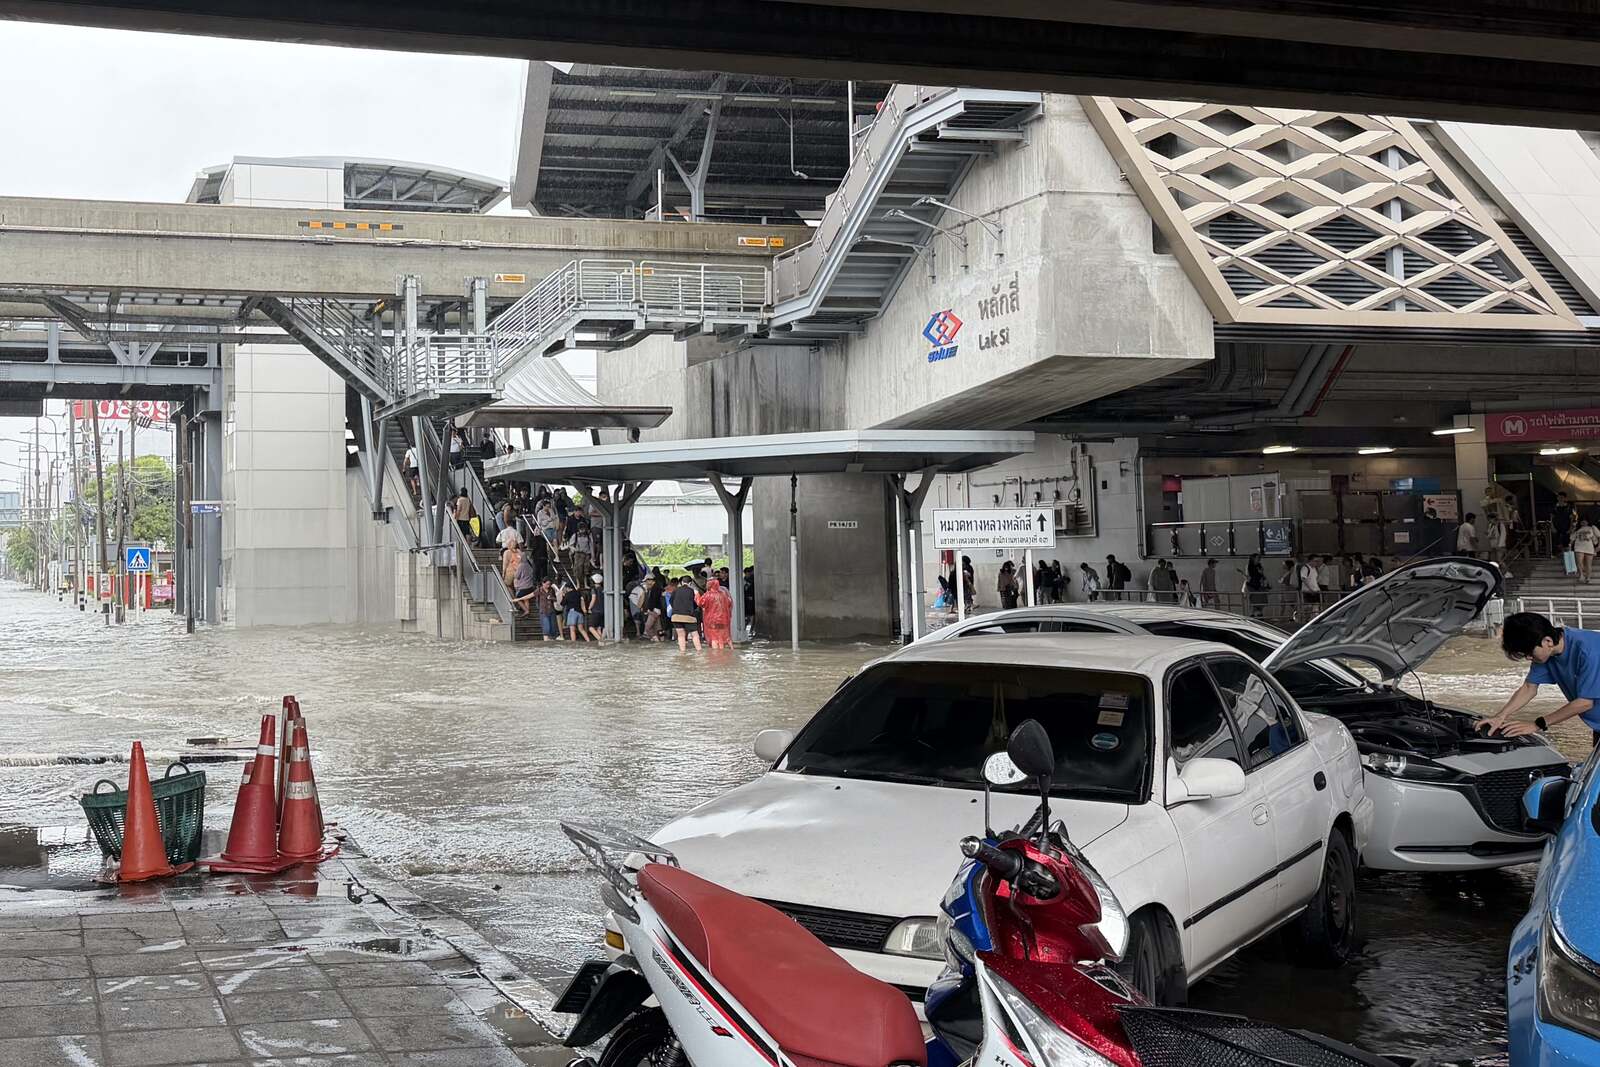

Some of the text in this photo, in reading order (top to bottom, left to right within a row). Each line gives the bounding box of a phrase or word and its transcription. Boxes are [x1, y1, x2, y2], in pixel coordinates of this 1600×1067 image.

[978, 271, 1020, 320] หลักสี่
[979, 327, 1010, 350] Lak Si
[940, 510, 1032, 532] หมวดทางหลวงหลักสี่
